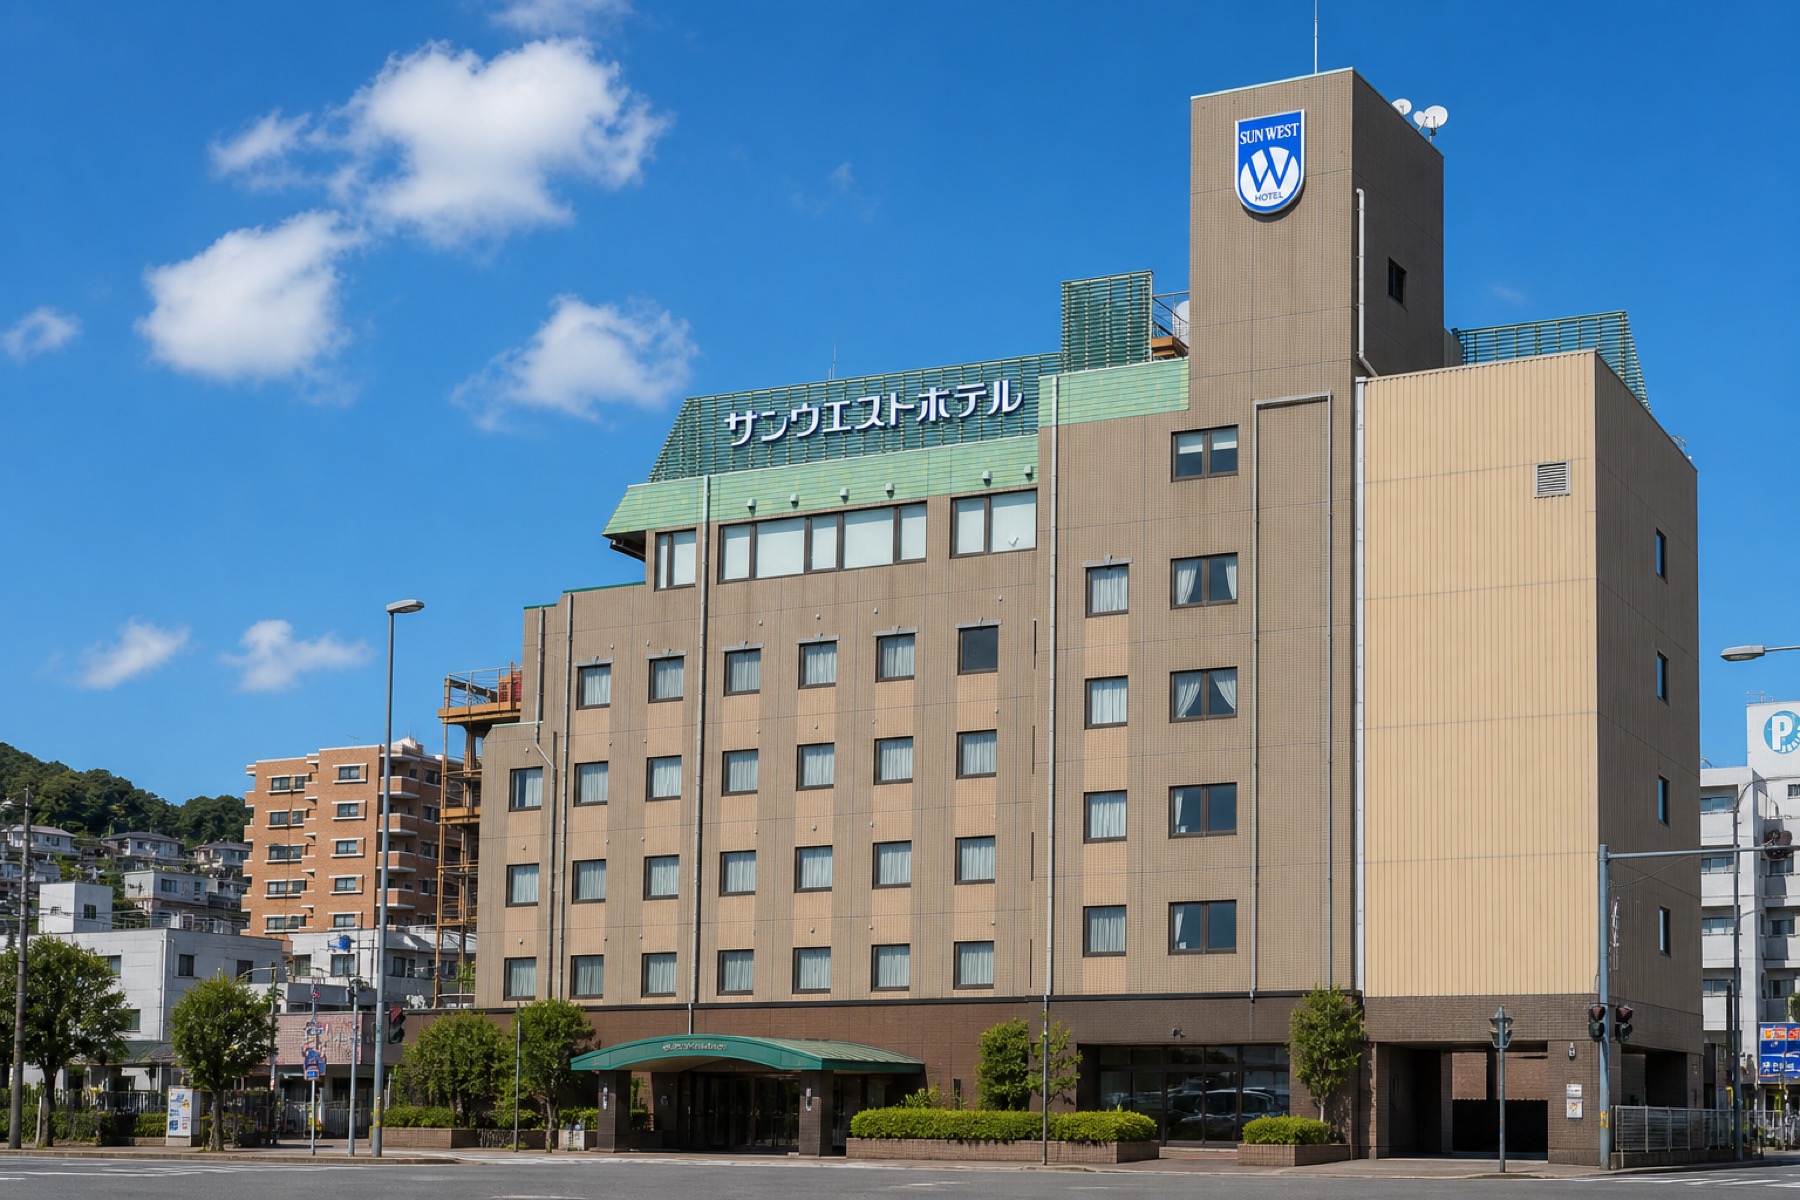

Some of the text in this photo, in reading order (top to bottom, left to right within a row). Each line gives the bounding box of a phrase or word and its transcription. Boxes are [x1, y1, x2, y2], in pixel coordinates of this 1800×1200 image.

[1240, 122, 1299, 145] SUN WEST
[1247, 147, 1294, 192] W
[1255, 191, 1283, 201] HOTEL
[724, 379, 1024, 447] サンウエストホテル
